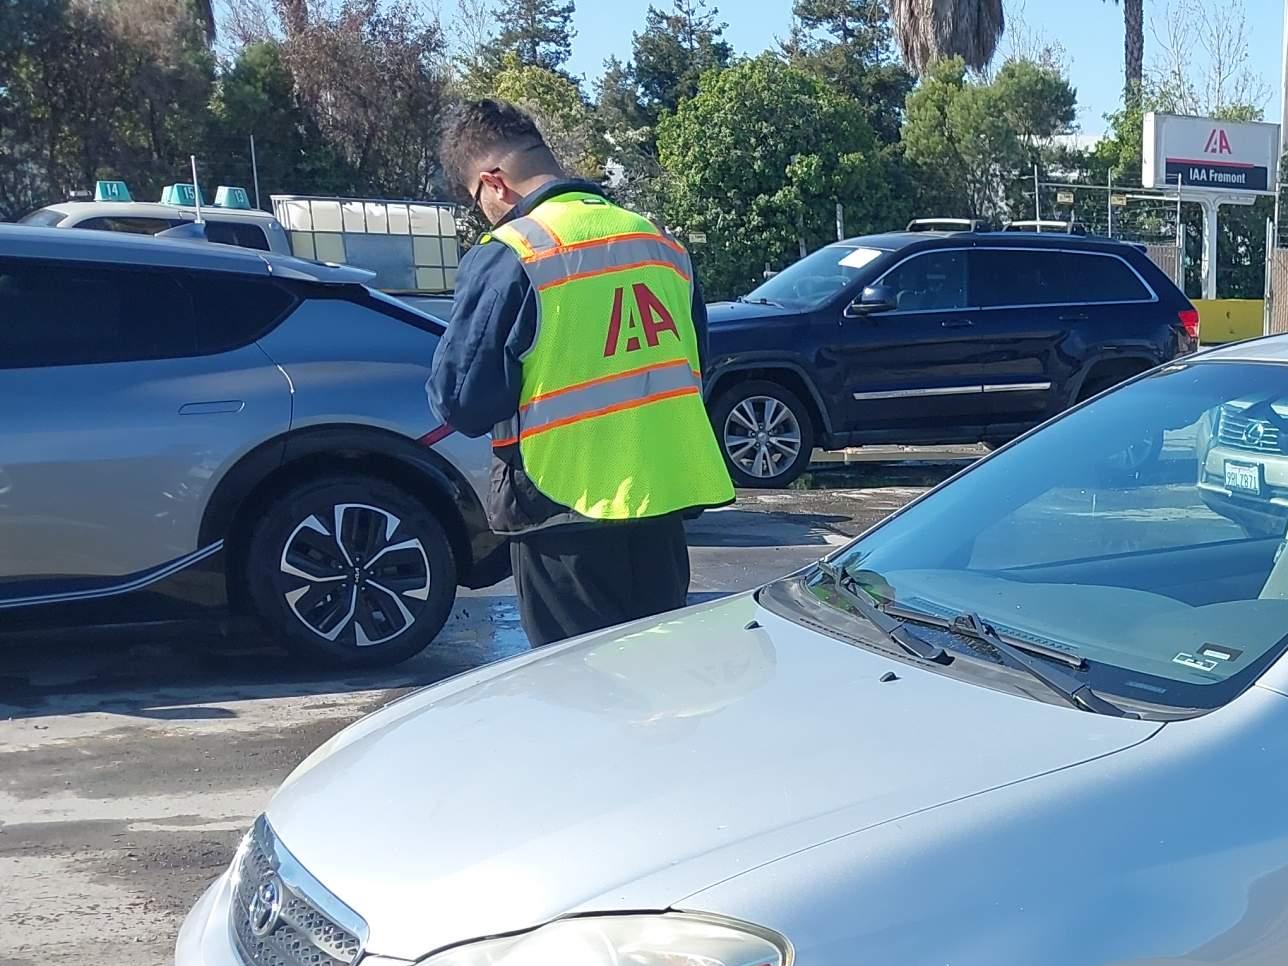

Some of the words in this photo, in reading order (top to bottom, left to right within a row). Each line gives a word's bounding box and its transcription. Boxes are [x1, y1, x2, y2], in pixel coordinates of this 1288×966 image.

[1189, 167, 1209, 181] IAA
[1209, 169, 1246, 184] Fremont
[106, 183, 119, 197] 14
[183, 186, 196, 200] 15
[234, 190, 245, 203] 13
